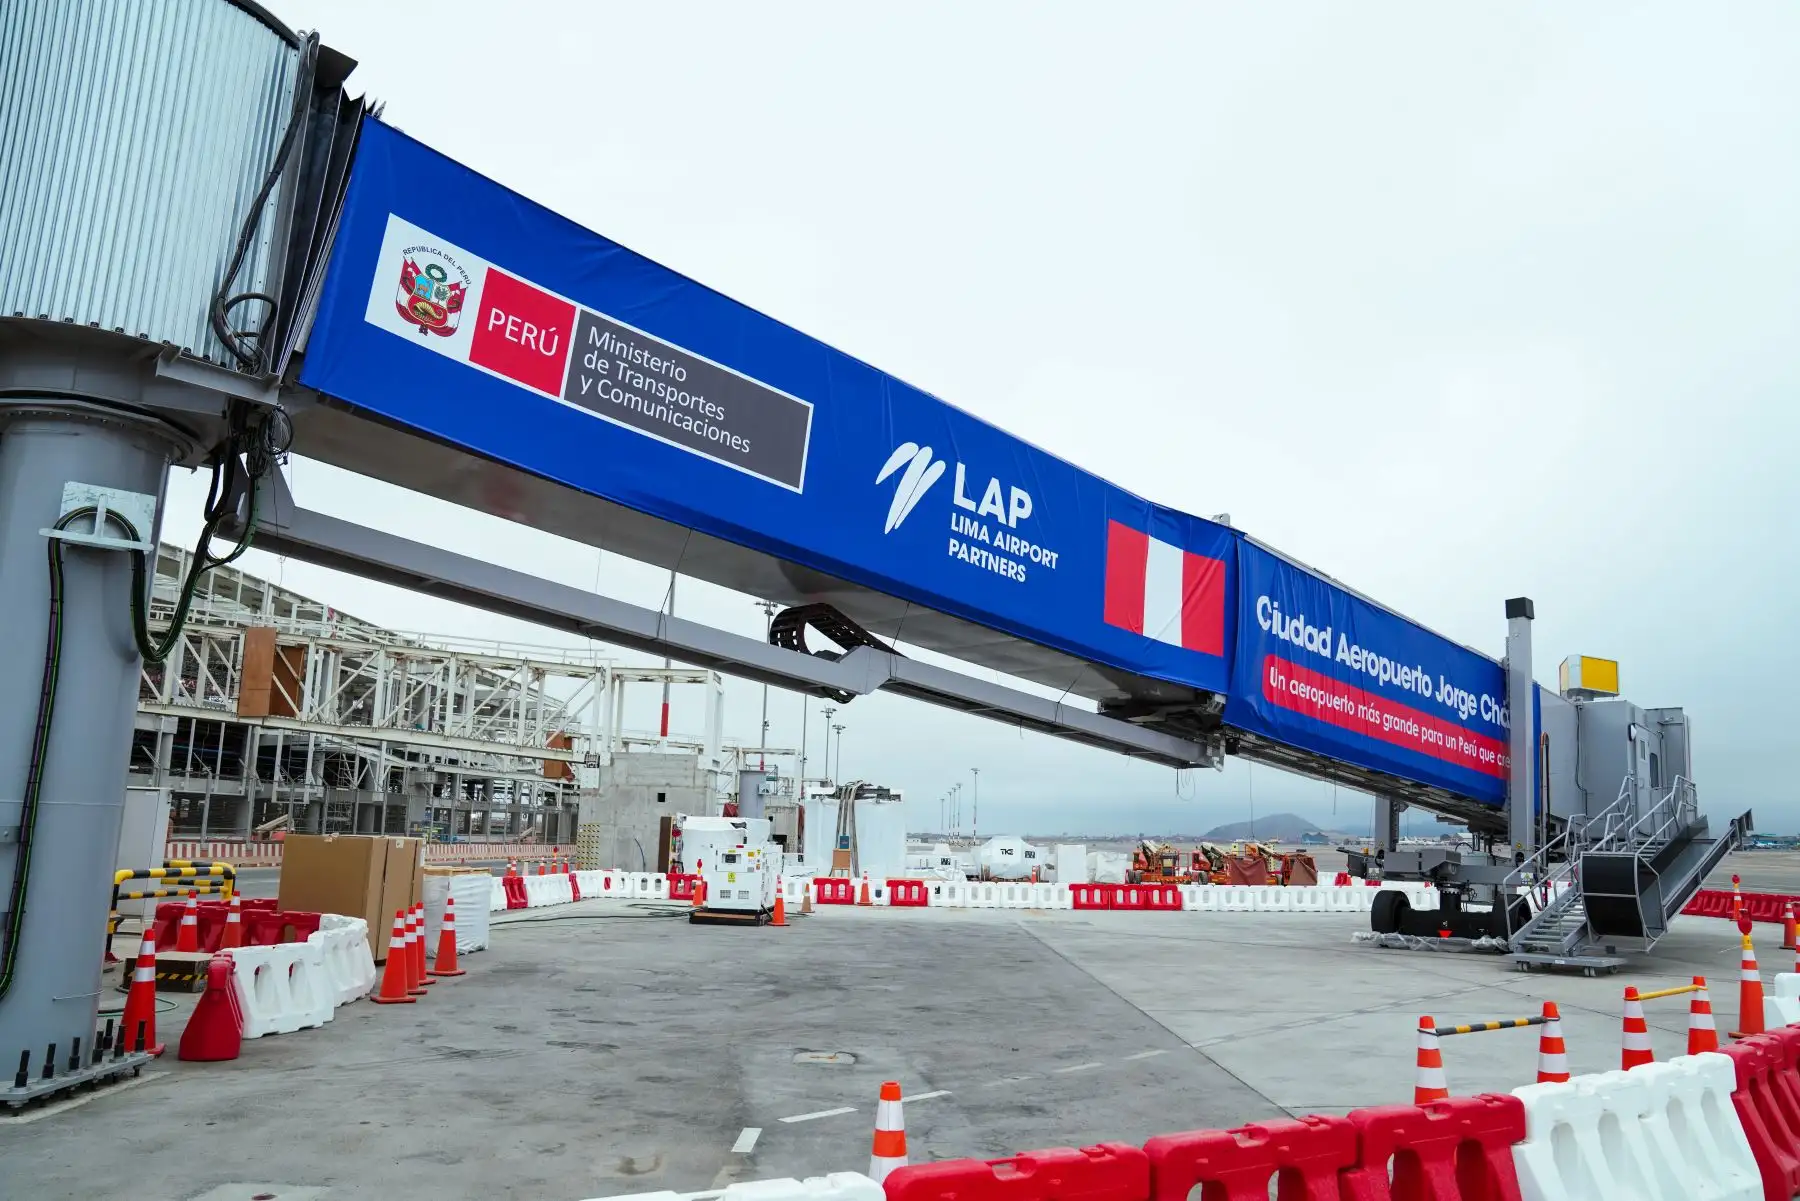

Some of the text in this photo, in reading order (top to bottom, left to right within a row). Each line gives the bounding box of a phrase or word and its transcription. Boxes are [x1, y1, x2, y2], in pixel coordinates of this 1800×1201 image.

[402, 245, 442, 257] REPUBLICA
[443, 254, 456, 267] DEL
[487, 307, 559, 357] PERÚ
[588, 325, 687, 382] Ministerio
[580, 374, 751, 453] y Comunicaciones
[583, 350, 725, 421] de Transportes
[953, 461, 1033, 529] LAP
[948, 537, 1026, 583] PARTNERS
[951, 512, 1059, 570] LIMA AIRPORT
[1256, 595, 1511, 729] Ciudad Aeropuerto Jorge Chá
[1269, 666, 1511, 769] Un aeropuerto más grande para un Perú que cre
